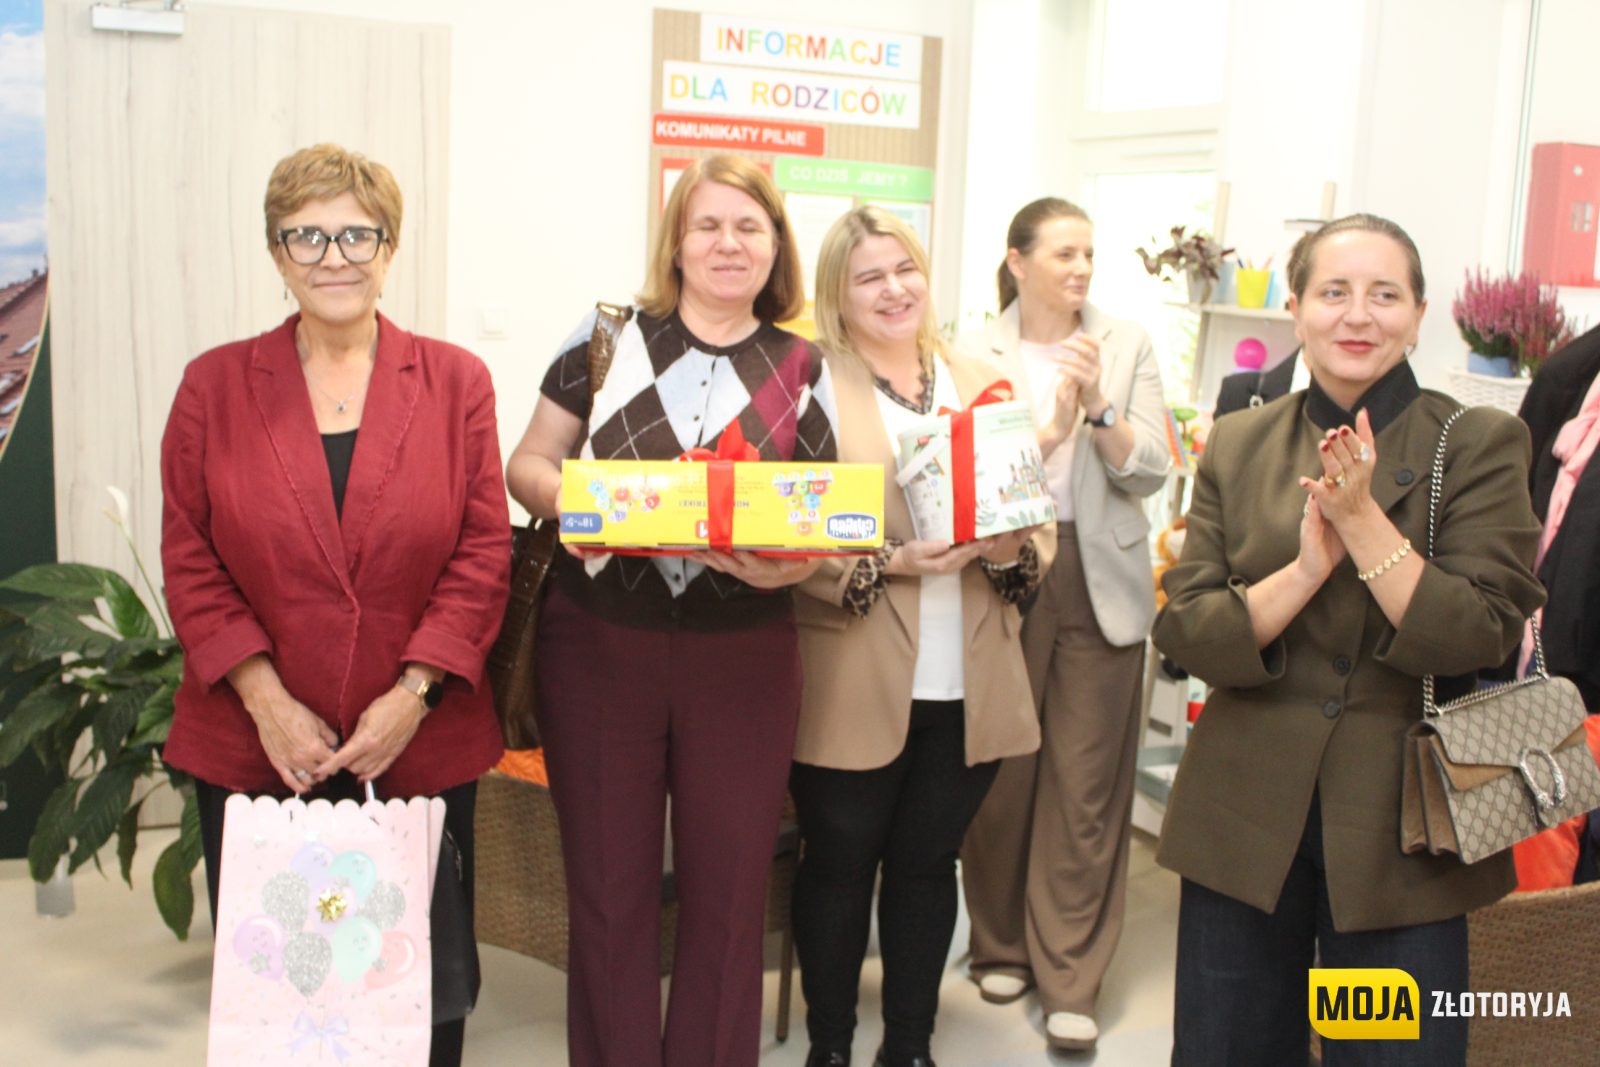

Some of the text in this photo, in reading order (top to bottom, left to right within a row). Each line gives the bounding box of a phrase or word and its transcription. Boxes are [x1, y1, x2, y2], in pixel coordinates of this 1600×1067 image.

[717, 26, 902, 67] INFORMACJE
[670, 73, 907, 116] DLA RODZICÓW
[656, 119, 807, 147] KOMUNIKATY PILNE
[789, 165, 812, 180] CO
[857, 169, 896, 186] JEMY
